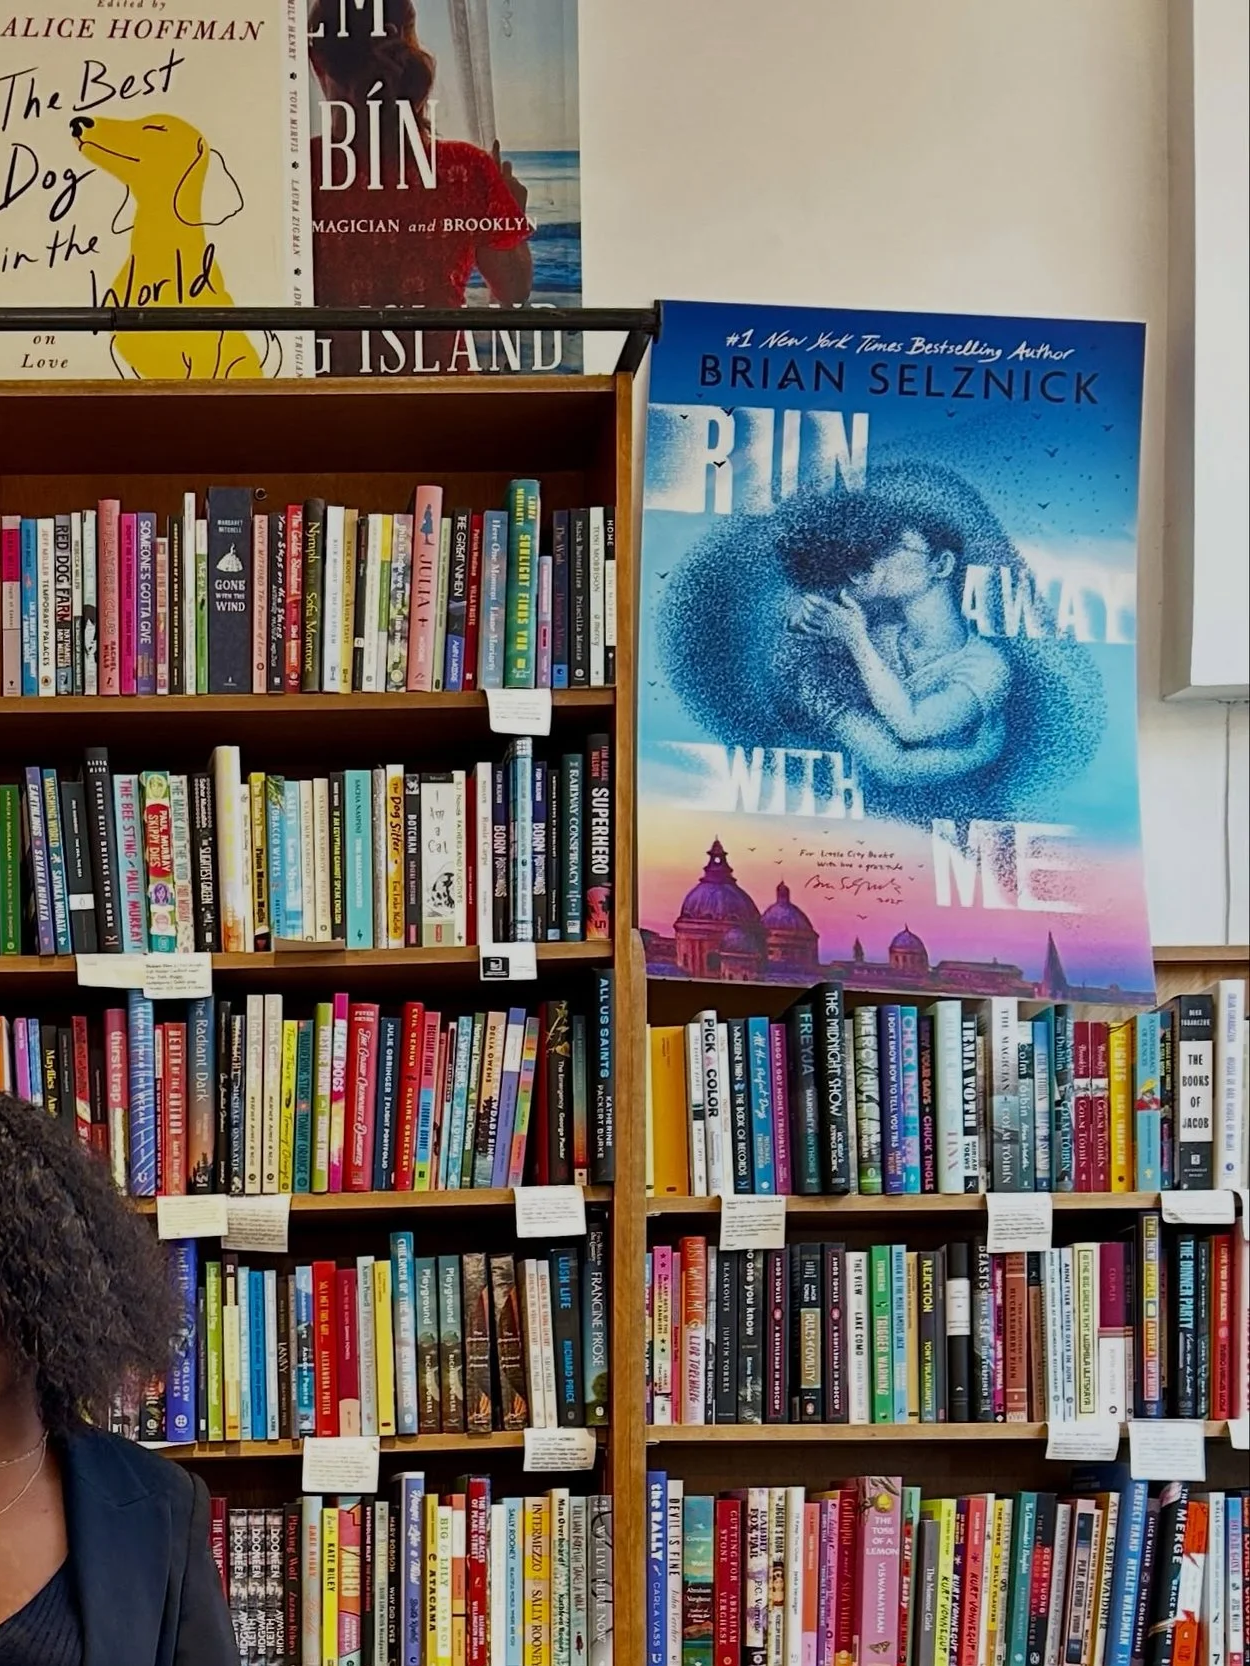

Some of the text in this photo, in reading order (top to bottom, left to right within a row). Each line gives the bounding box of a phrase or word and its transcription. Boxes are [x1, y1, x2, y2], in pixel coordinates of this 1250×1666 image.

[0, 17, 265, 41] ALICE HOFFMAN
[73, 48, 185, 112] Best
[2, 224, 101, 273] in the
[312, 216, 538, 233] MAGICIAN and BROOKLYN
[90, 243, 218, 330] World
[20, 335, 69, 369] on Love
[358, 304, 564, 374] ISLAND
[726, 329, 1076, 363] #1 New York Times Bestselling Author
[700, 354, 1101, 406] BRIAN SELZNICK
[665, 402, 870, 515] RUN
[55, 525, 71, 622] RED DOG FARM
[215, 580, 246, 591] GONE
[215, 601, 246, 612] WIND
[417, 552, 433, 610] JULIA
[516, 534, 531, 650] SUNLIGHT FINDS YOU
[961, 563, 1138, 645] AWAY
[708, 742, 866, 819] WITH
[119, 778, 138, 860] THE BEE STING
[591, 787, 611, 875] SUPERHERO
[930, 818, 1080, 913] ME
[825, 991, 842, 1117] THE MIDNIGHT SHOW
[1182, 1054, 1210, 1129] THE BOOKS OF JACOB
[532, 1503, 543, 1573] INTERMEZZO
[877, 1561, 887, 1634] VISWANATHAN
